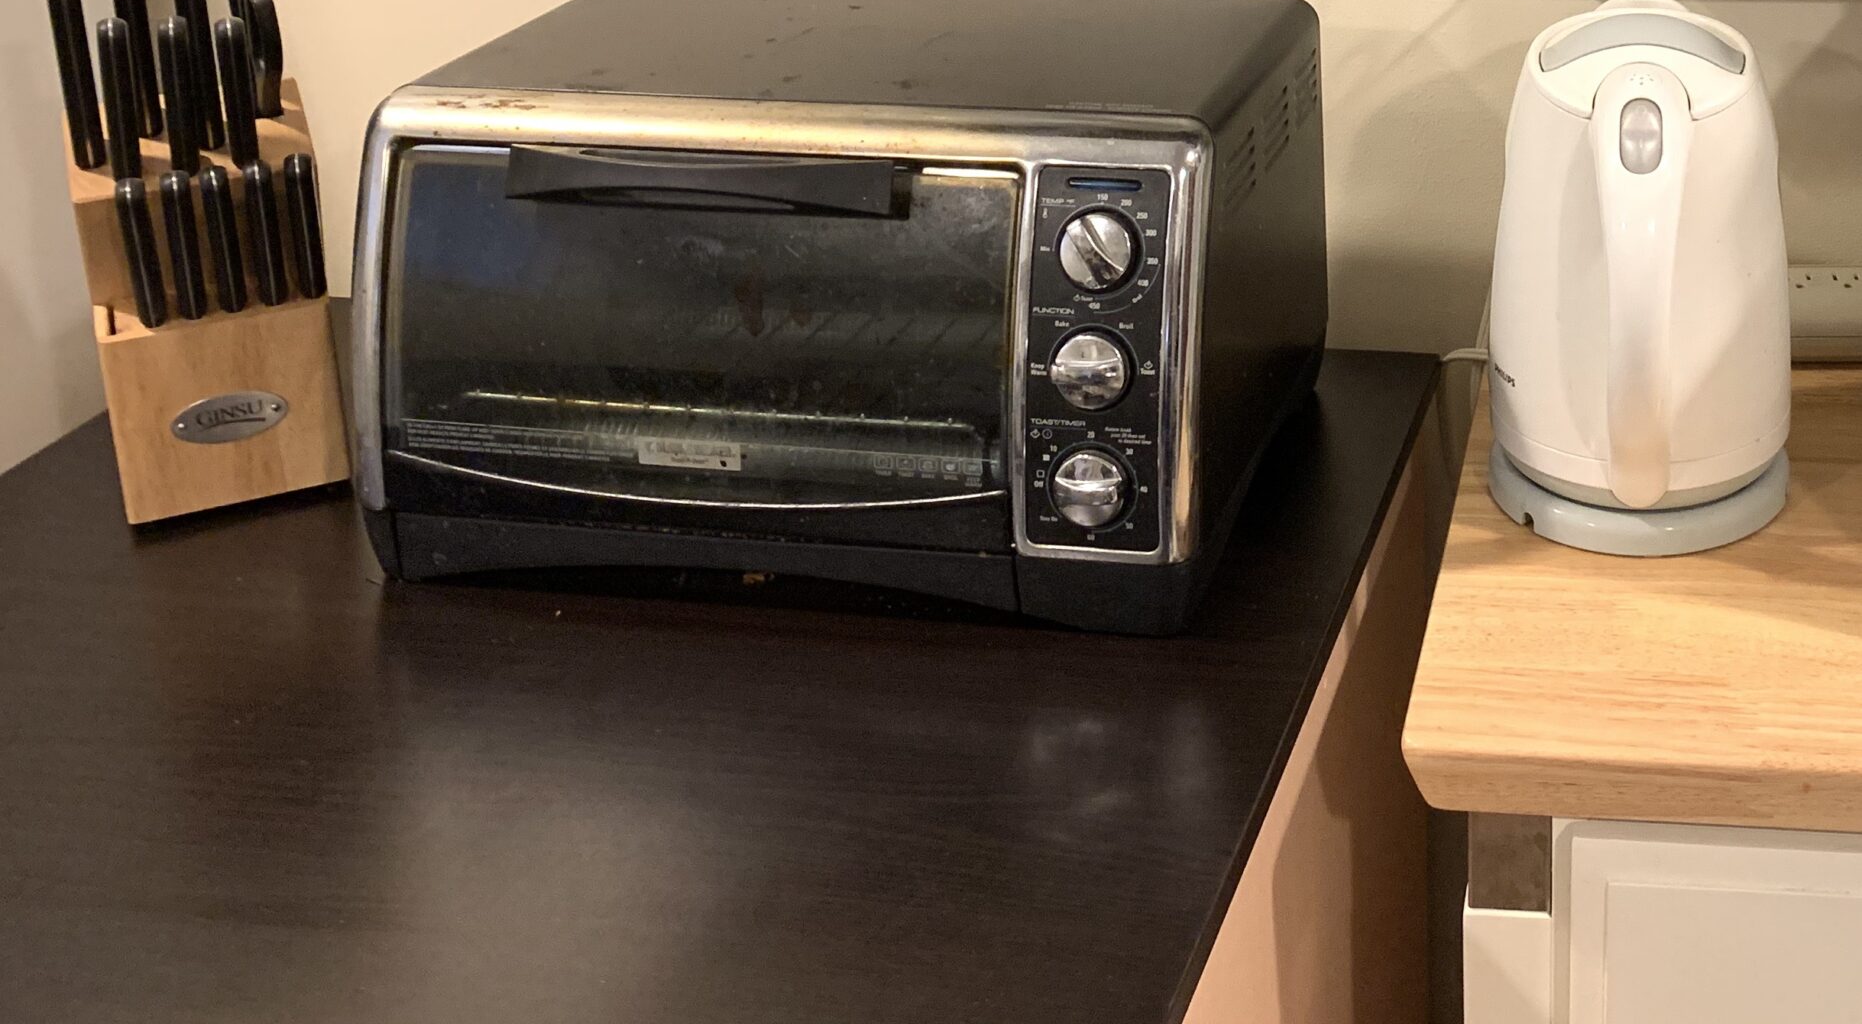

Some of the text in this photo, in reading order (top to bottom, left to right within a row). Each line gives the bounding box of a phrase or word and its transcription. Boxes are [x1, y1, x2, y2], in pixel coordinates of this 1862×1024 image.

[1088, 302, 1100, 310] 450
[1032, 306, 1075, 315] FUNCTION
[1119, 322, 1134, 330] Broil
[195, 399, 264, 427] GINSU
[1030, 418, 1086, 427] TOAST/TIMER
[1087, 431, 1095, 439] 20
